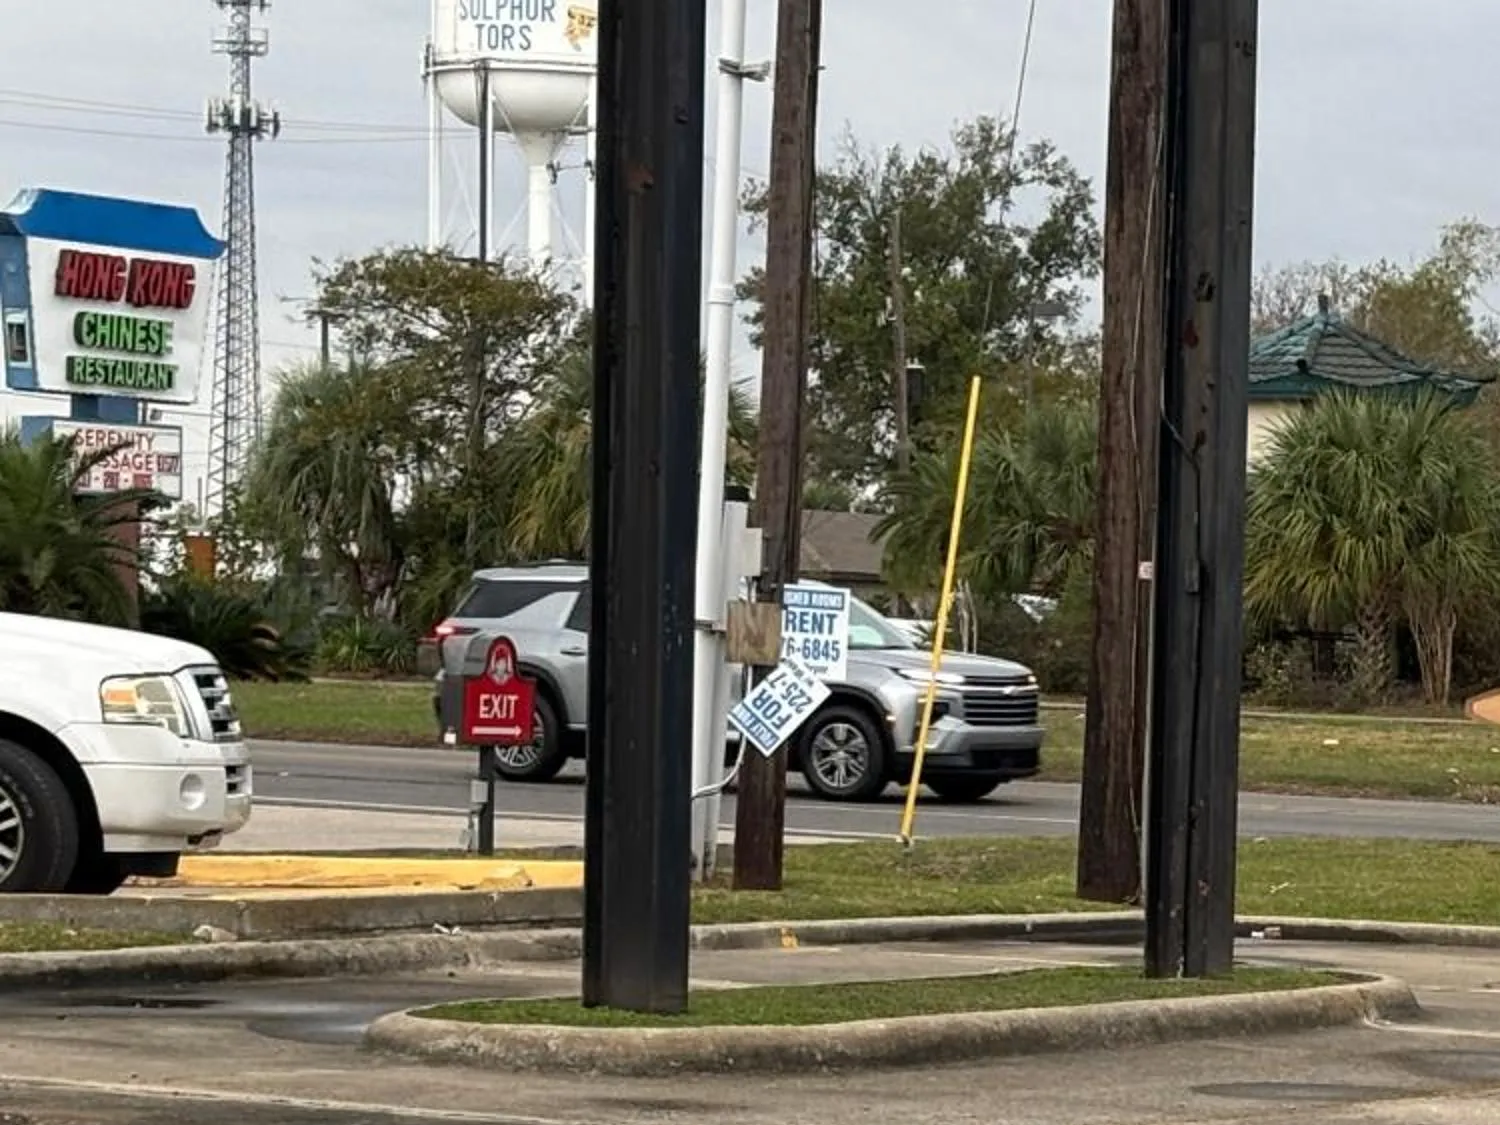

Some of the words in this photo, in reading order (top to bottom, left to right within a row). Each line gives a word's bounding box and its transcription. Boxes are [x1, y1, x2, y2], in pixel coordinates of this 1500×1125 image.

[458, 0, 555, 22] SULPHUR
[475, 24, 532, 51] TORS
[55, 249, 127, 302] HONG
[126, 258, 196, 309] KONG
[74, 311, 174, 358] CHINESE
[66, 356, 179, 390] RESTAURANT
[785, 611, 837, 635] RENT
[479, 694, 519, 719] EXIT
[751, 688, 793, 730] FOR
